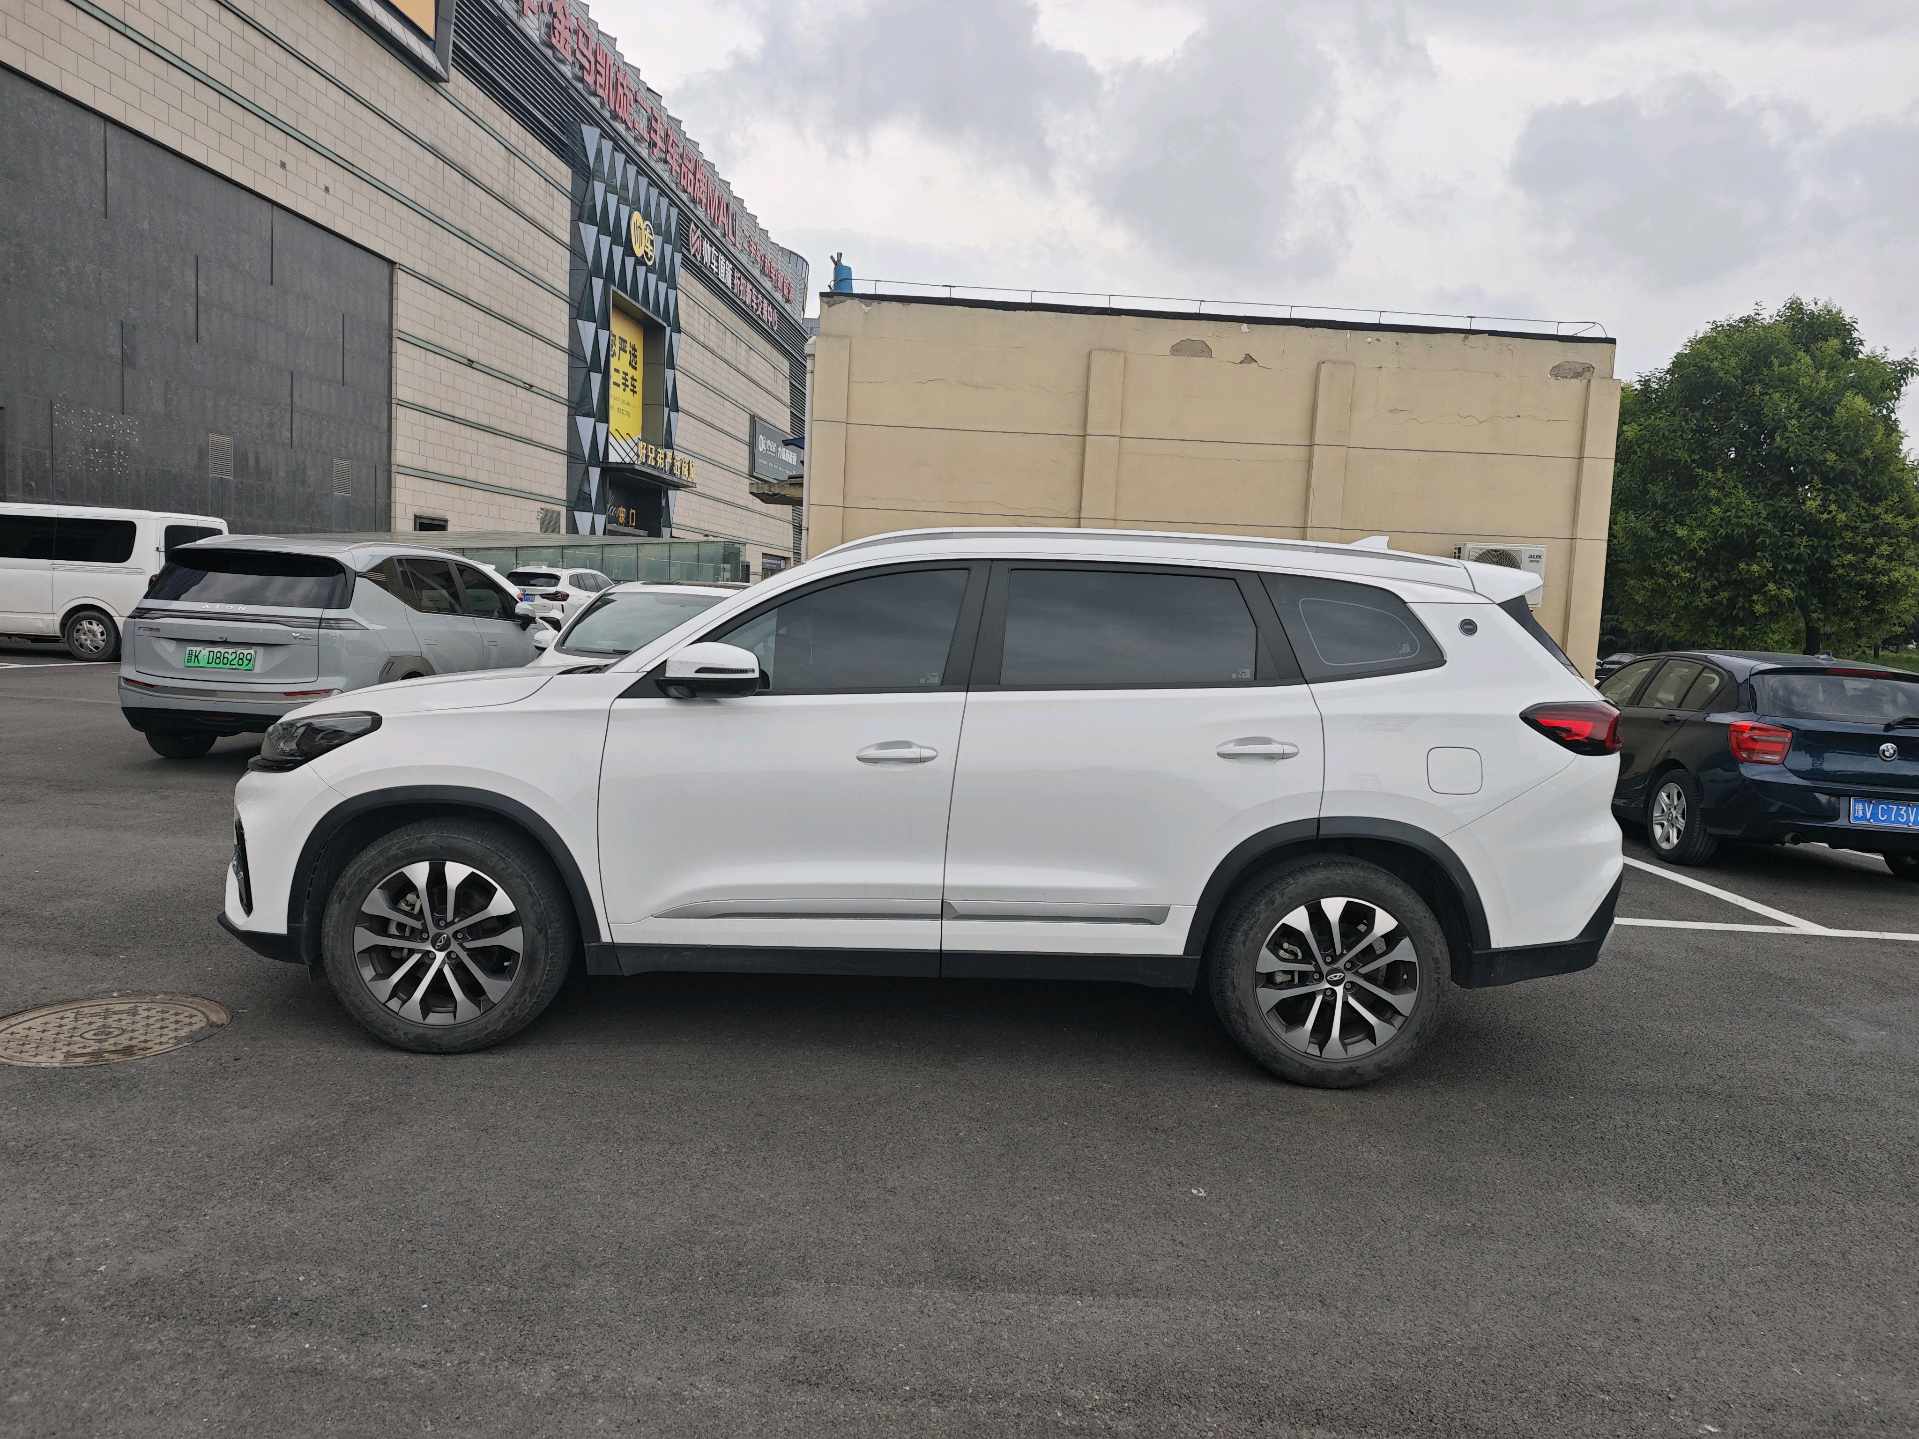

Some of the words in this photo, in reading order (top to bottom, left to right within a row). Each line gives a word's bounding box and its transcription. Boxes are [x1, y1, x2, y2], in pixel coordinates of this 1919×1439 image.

[613, 367, 638, 397] 二手车
[1879, 804, 1919, 823] C73V
